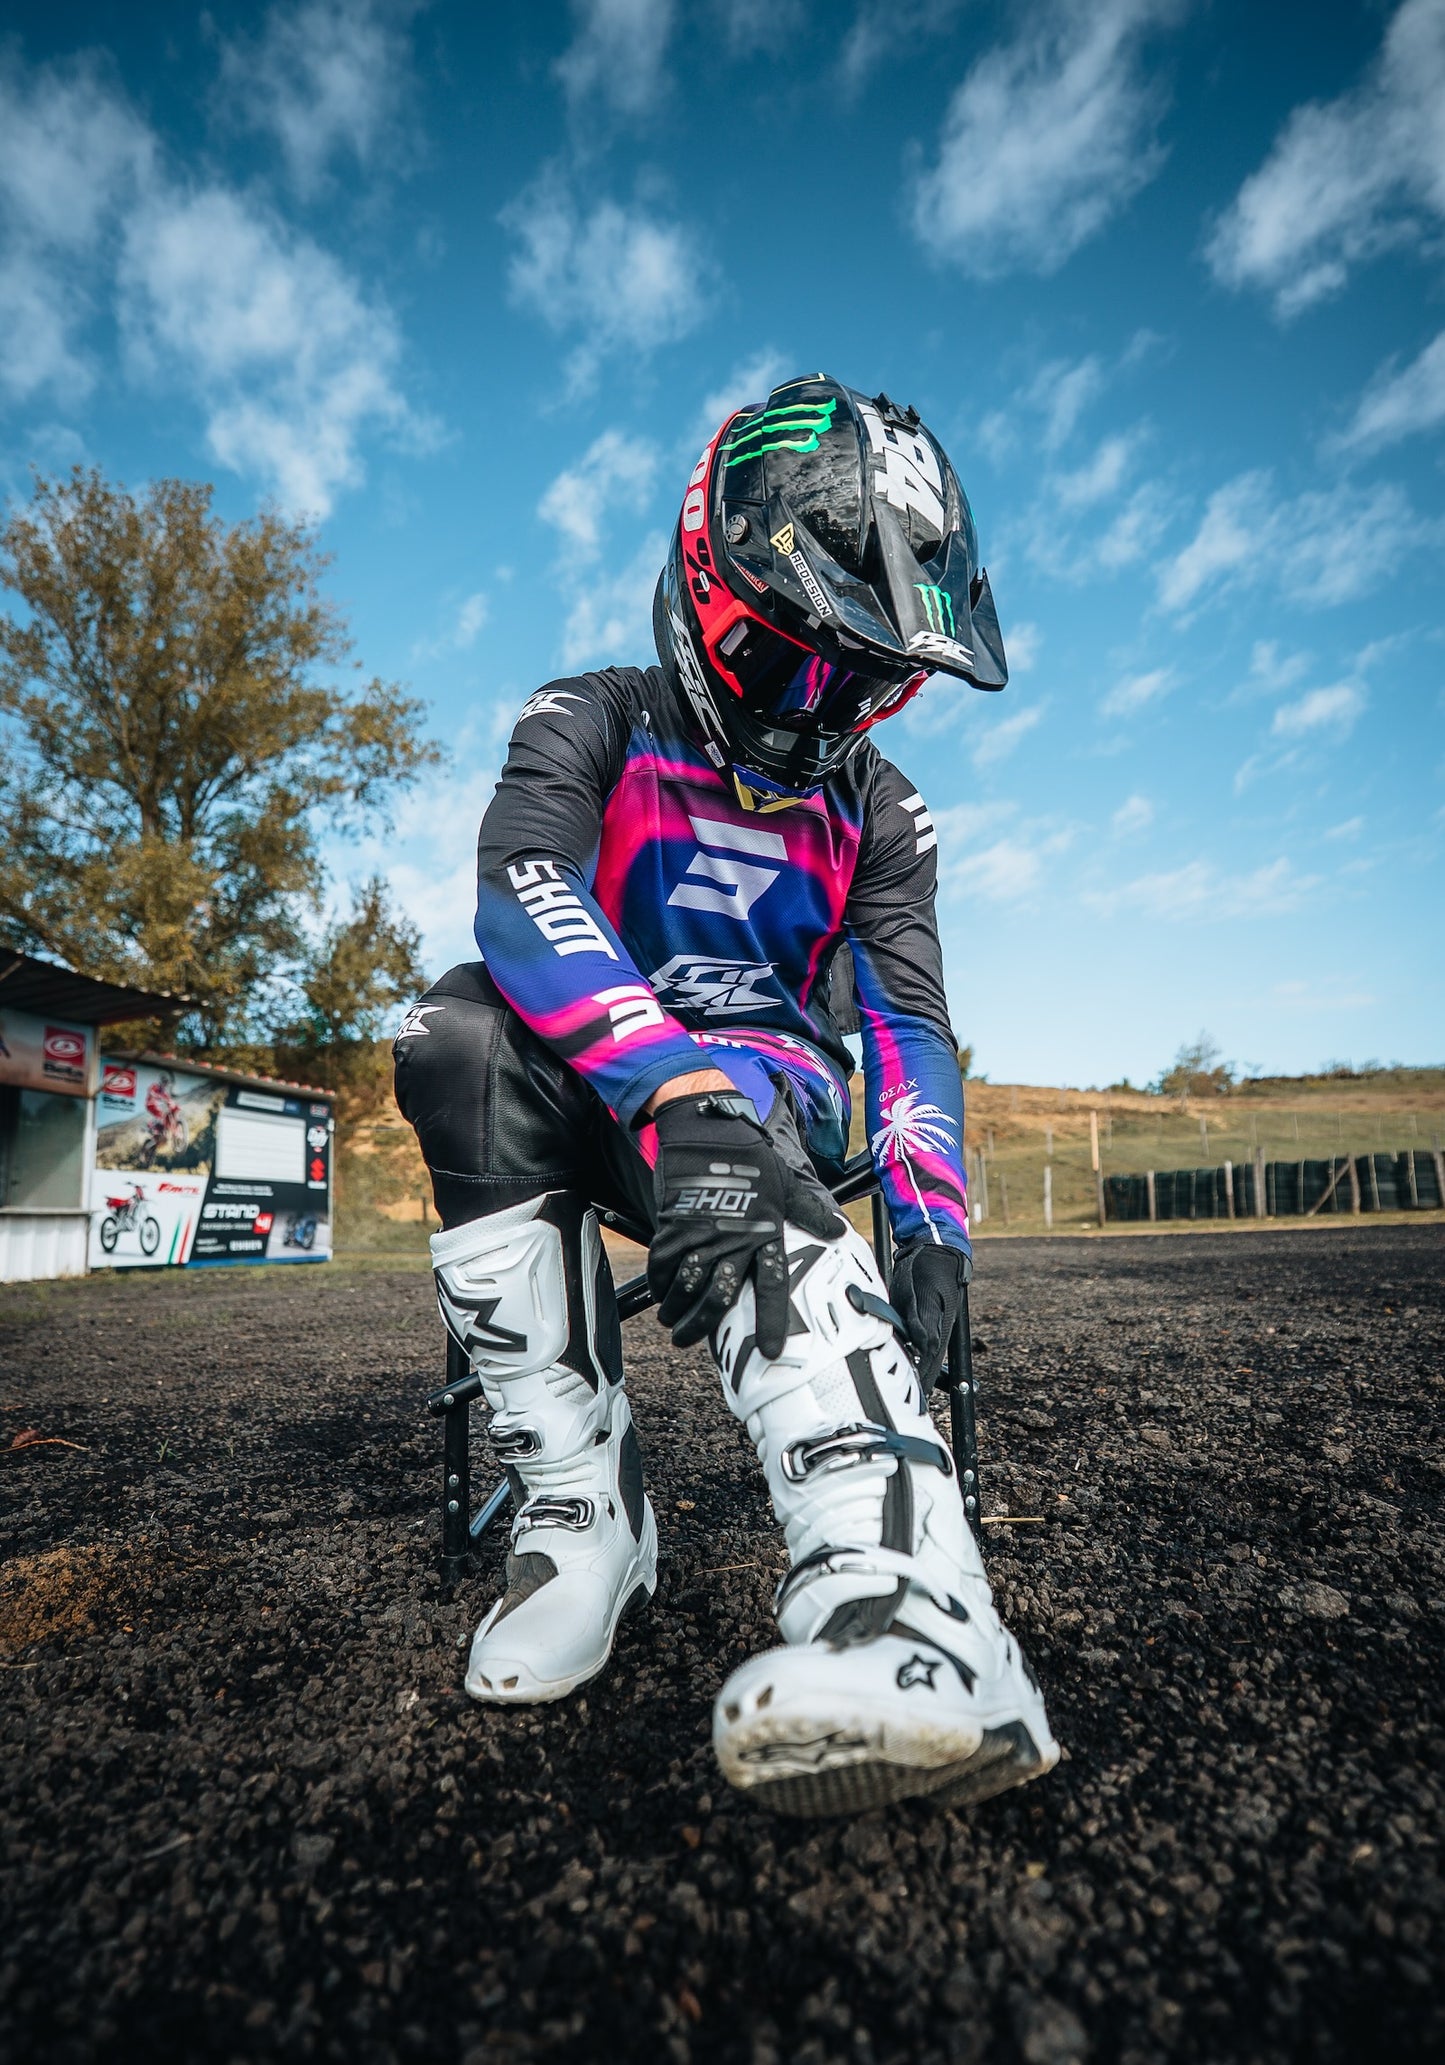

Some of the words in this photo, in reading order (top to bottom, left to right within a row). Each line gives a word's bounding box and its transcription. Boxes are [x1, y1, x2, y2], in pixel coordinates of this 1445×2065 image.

[791, 552, 830, 618] REDESIGN
[506, 861, 620, 961] SHOT
[675, 1189, 758, 1212] SHOT
